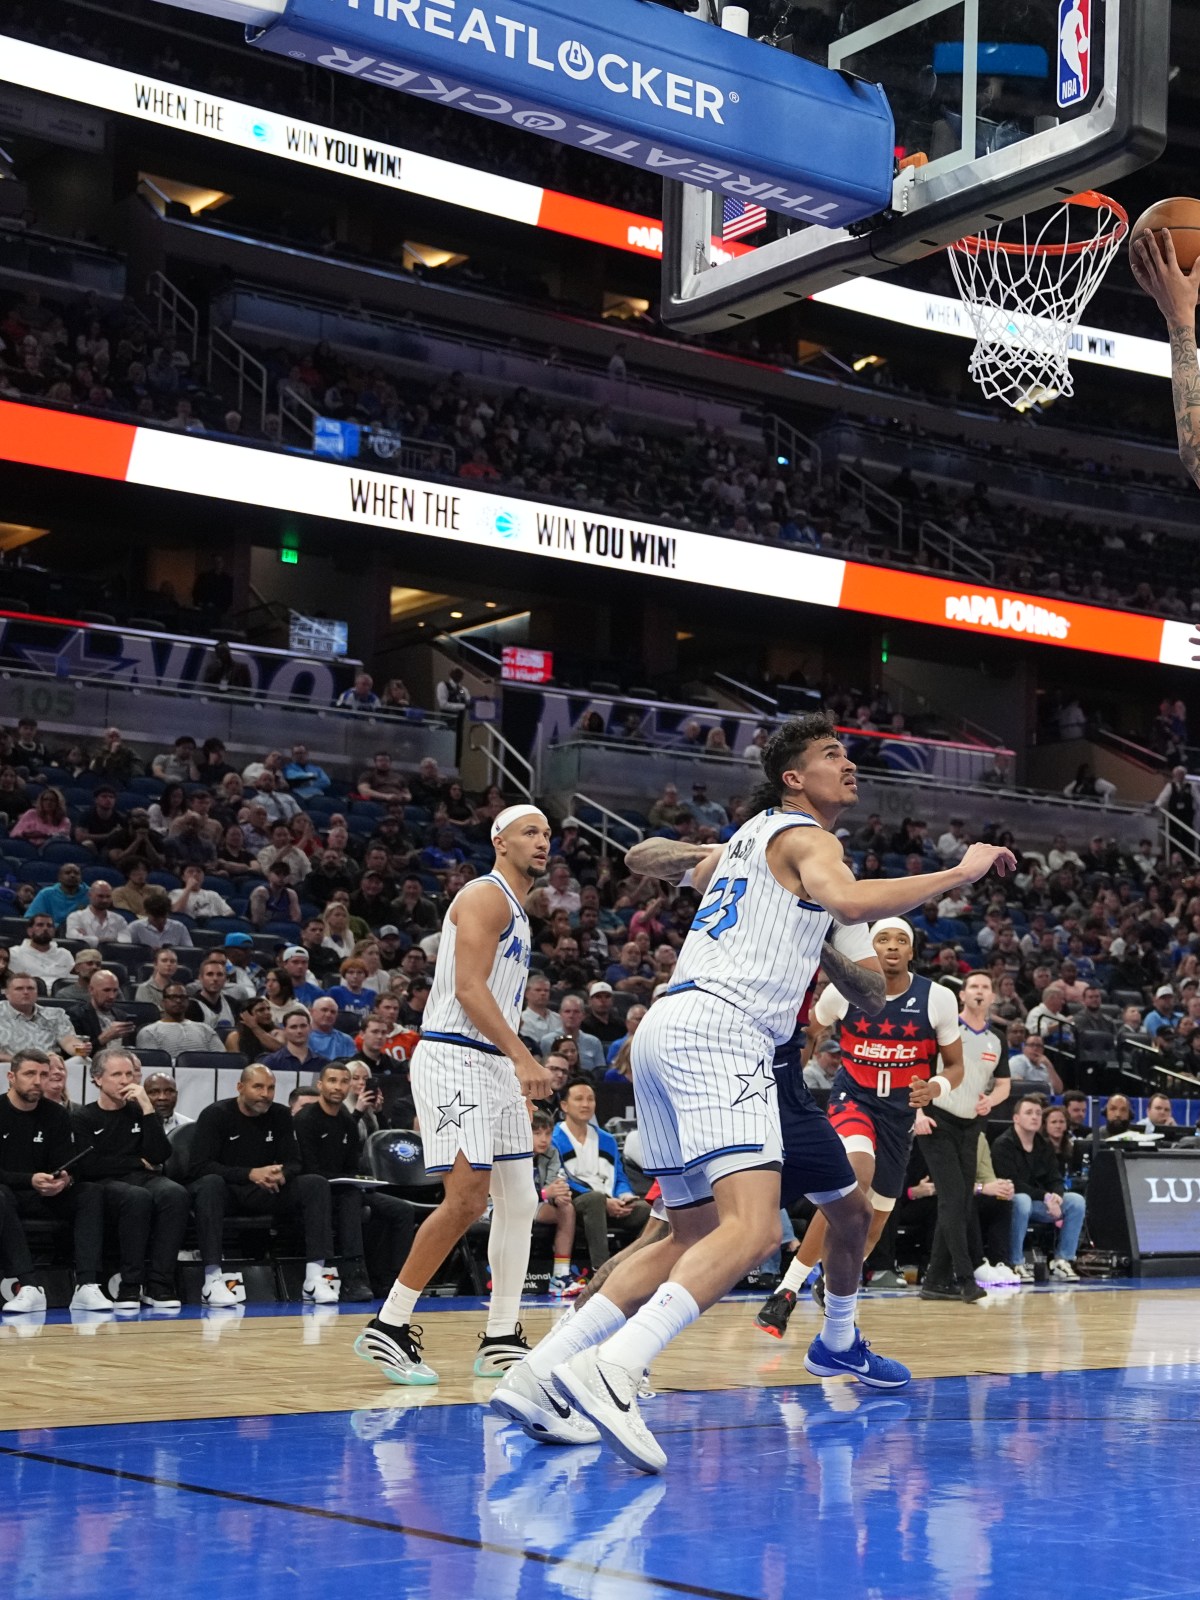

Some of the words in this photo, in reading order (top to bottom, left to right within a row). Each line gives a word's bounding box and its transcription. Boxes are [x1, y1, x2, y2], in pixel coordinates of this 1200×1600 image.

[1062, 78, 1077, 100] NBA
[135, 82, 188, 121] WHEN
[194, 100, 224, 132] THE
[286, 125, 318, 157] WIN
[324, 136, 357, 168] YOU
[363, 147, 402, 179] WIN!
[350, 478, 415, 522] WHEN
[423, 492, 461, 530] THE
[536, 512, 576, 550] WIN
[583, 521, 624, 559] YOU
[630, 531, 676, 569] WIN!
[853, 1040, 918, 1060] district
[877, 1070, 891, 1098] 0
